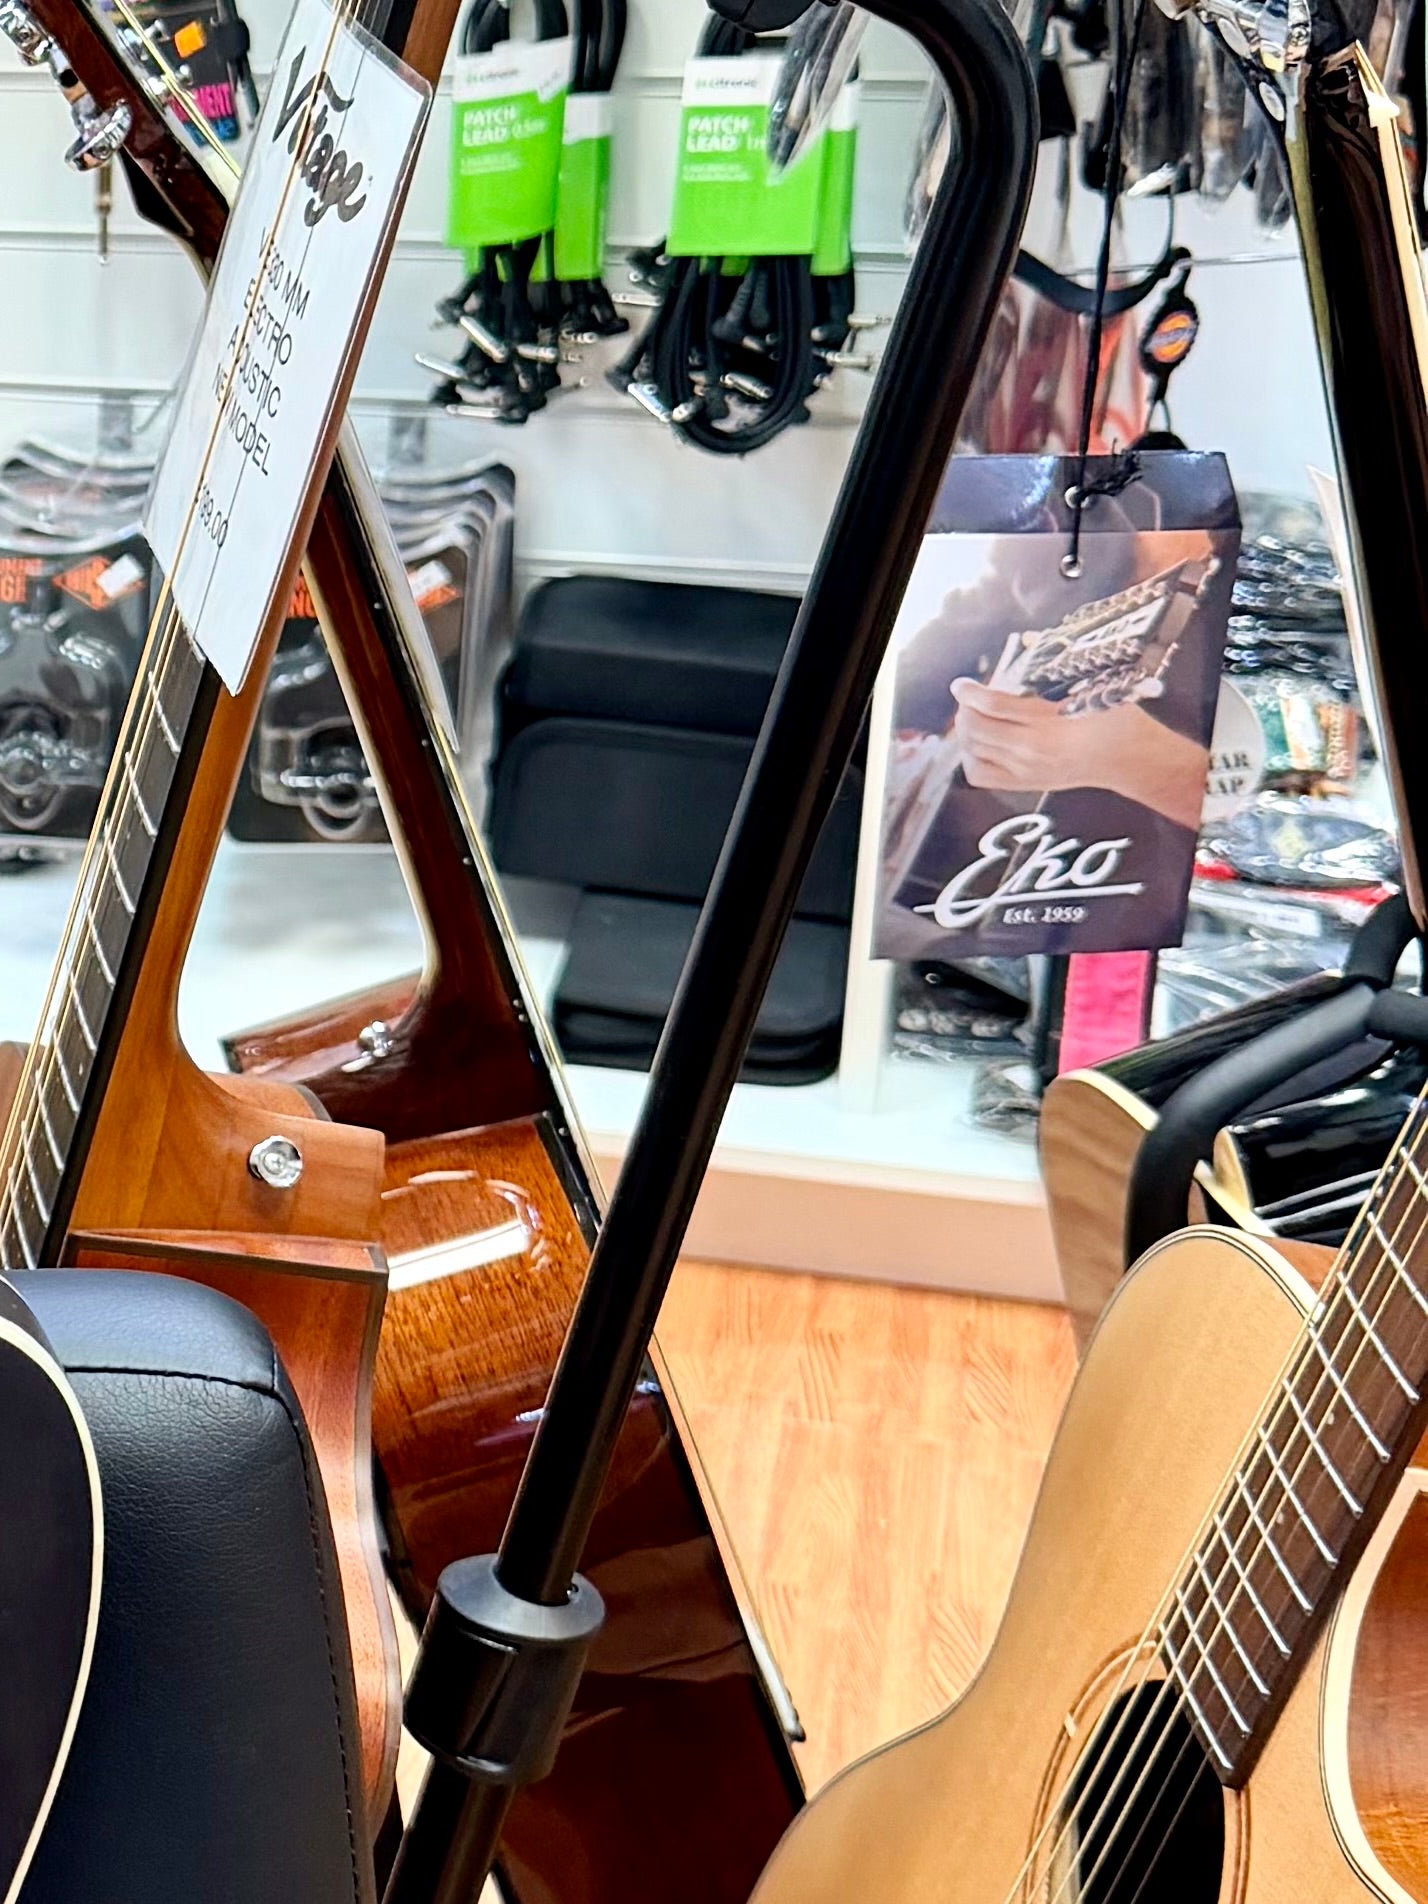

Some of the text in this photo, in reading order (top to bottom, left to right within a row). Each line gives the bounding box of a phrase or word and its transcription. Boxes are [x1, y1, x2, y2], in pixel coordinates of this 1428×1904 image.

[463, 105, 517, 128] PATCH
[687, 115, 750, 133] PATCH
[463, 126, 508, 147] LEAD
[686, 134, 740, 153] LEAD
[281, 270, 311, 321] MM
[935, 812, 1133, 930] Eko
[1002, 905, 1088, 926] Est. 1959
